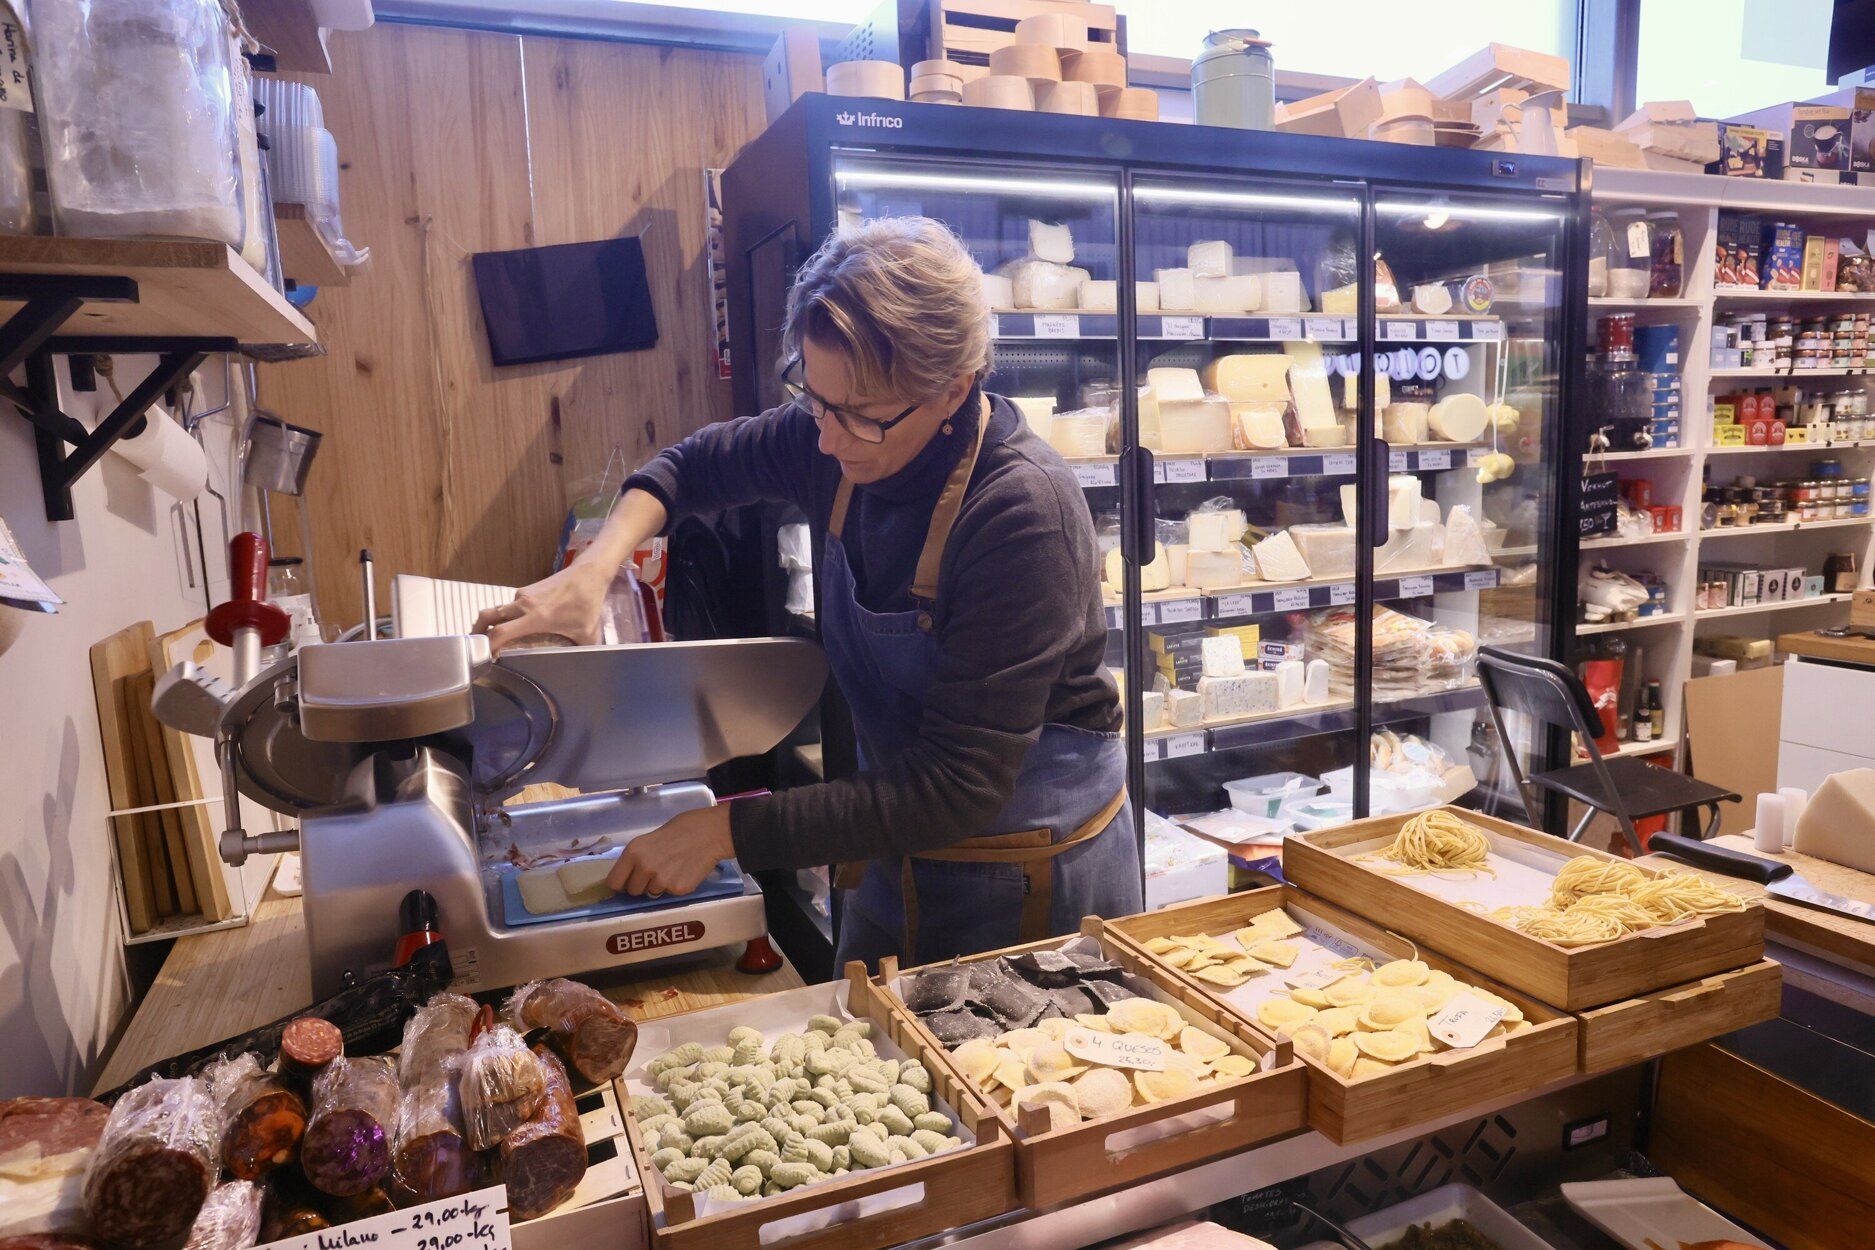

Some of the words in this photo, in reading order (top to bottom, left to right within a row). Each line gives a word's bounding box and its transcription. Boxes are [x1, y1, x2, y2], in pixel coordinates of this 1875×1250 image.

[857, 111, 903, 129] Infrico
[616, 925, 696, 952] BERKEL
[1092, 1036, 1102, 1048] 4
[318, 1229, 379, 1250] Milano
